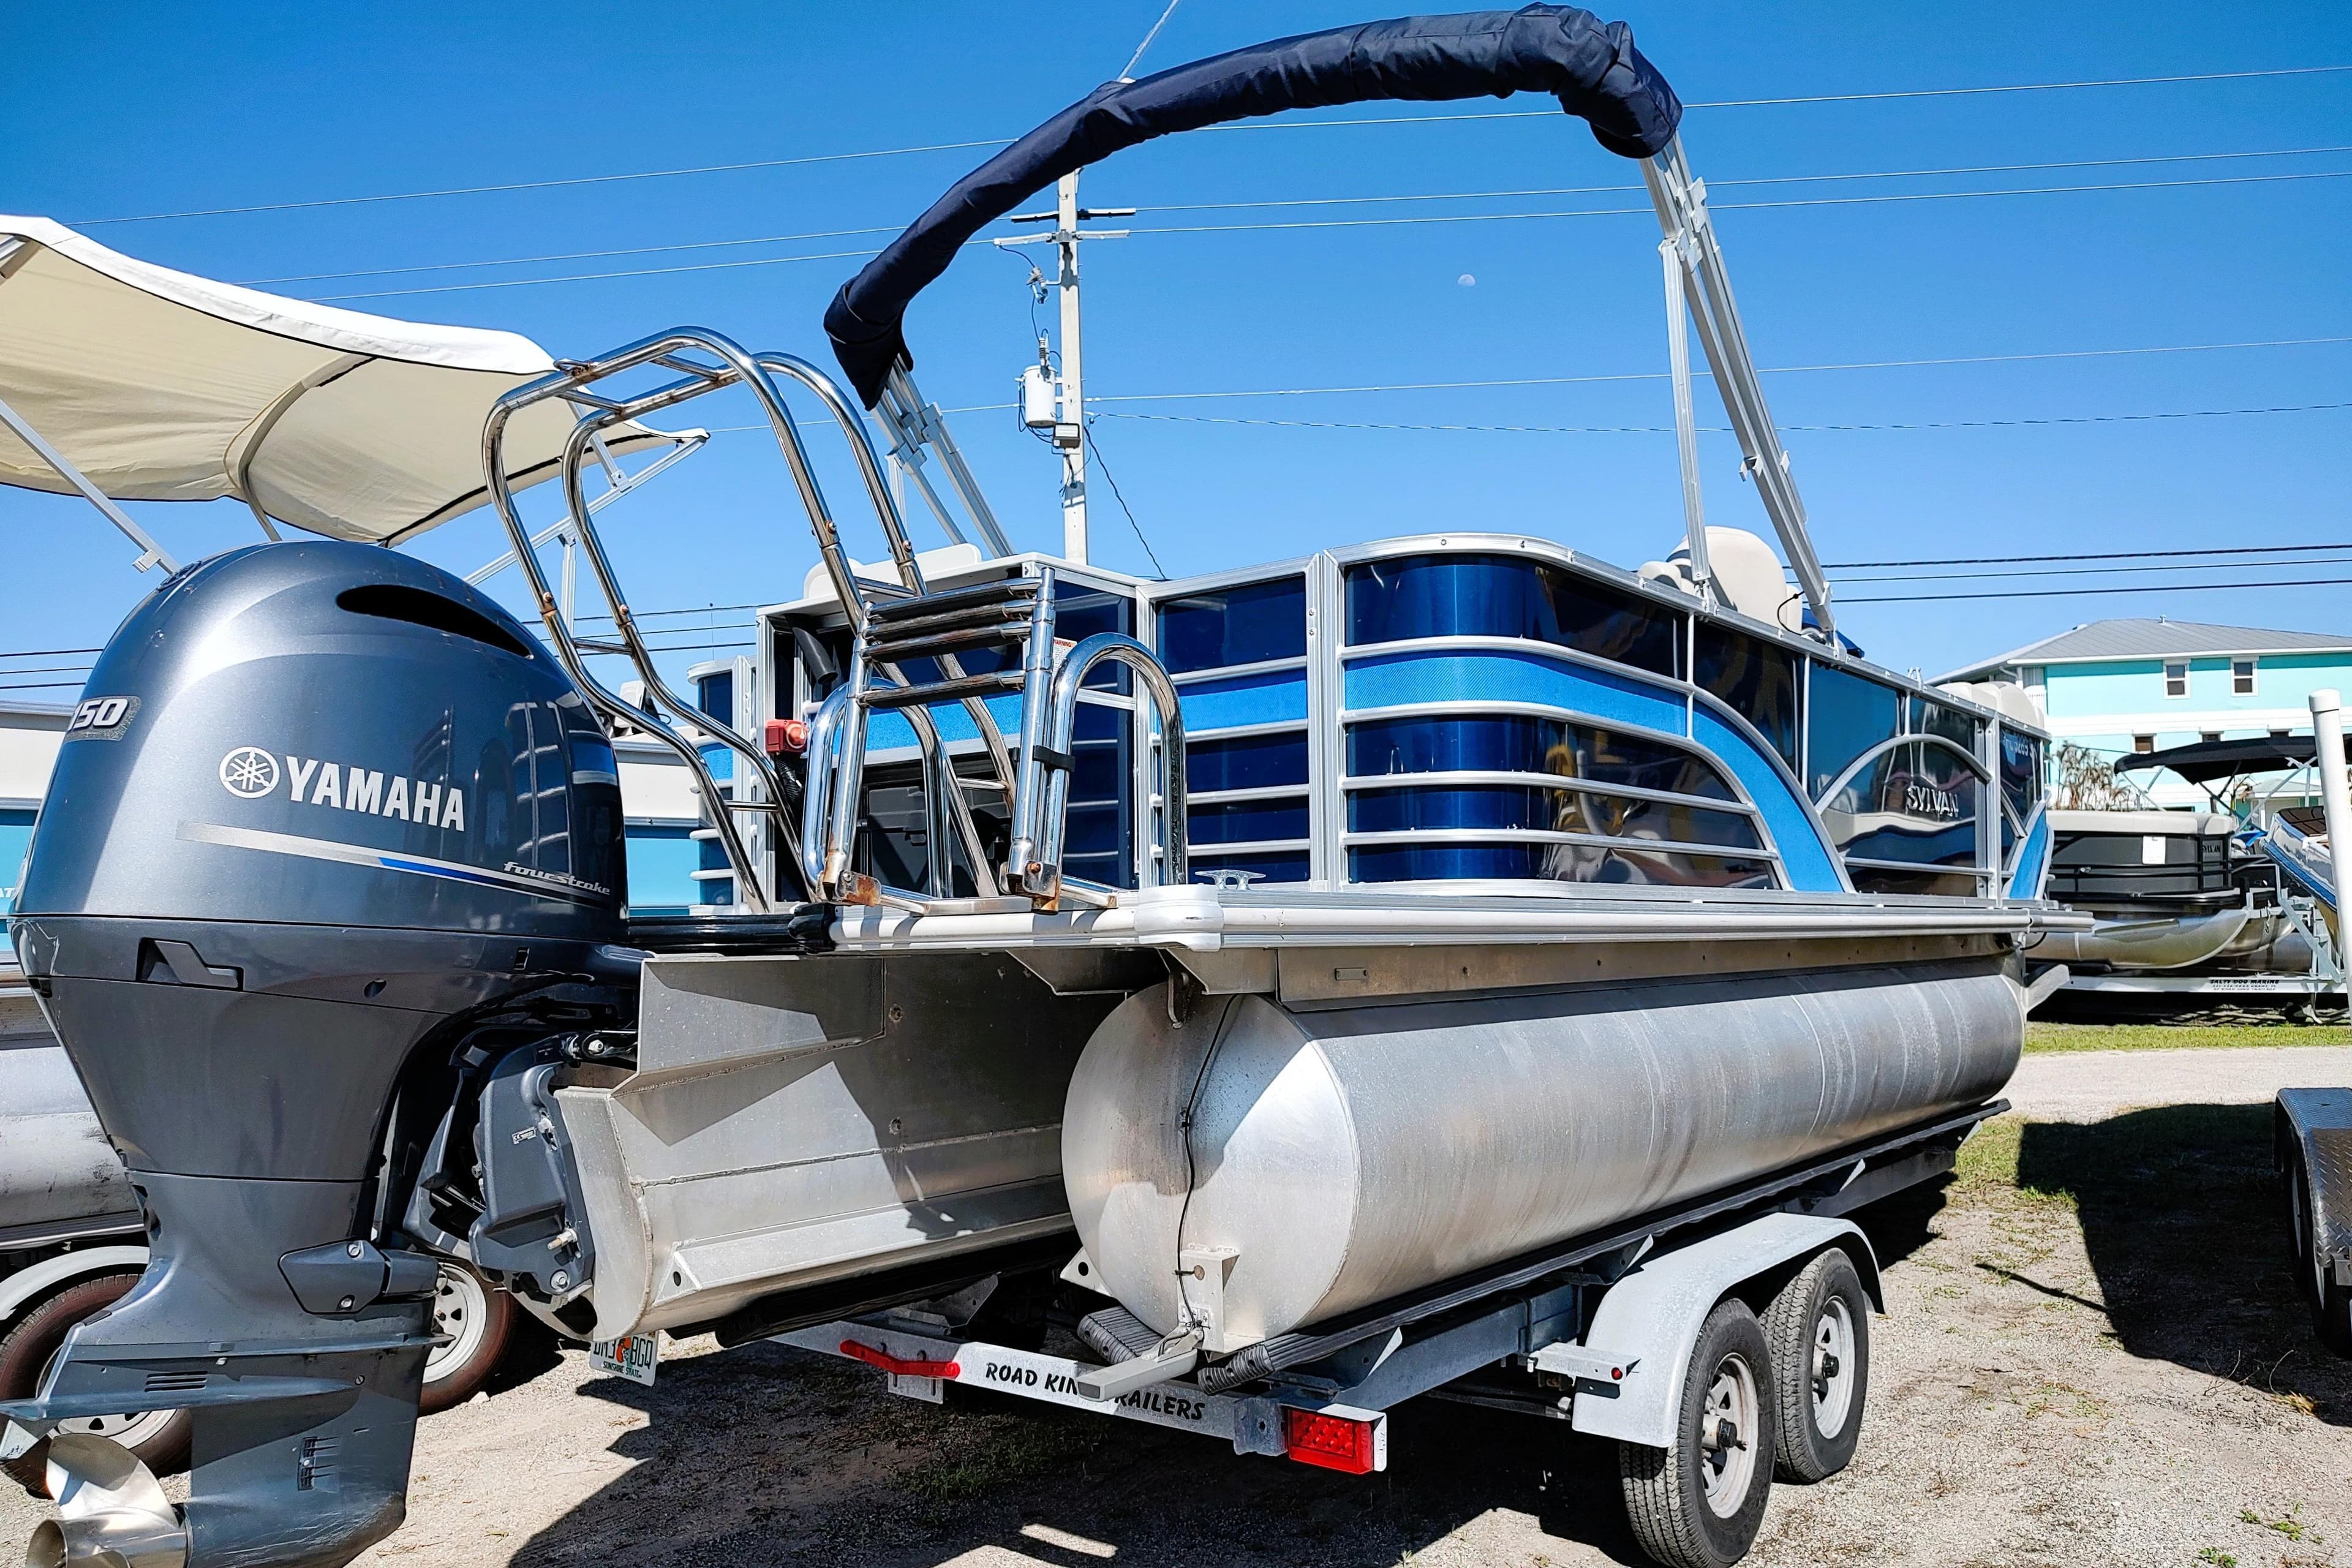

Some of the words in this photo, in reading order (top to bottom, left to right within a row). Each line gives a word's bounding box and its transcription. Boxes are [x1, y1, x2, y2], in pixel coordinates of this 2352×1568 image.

[68, 698, 129, 731] 150
[285, 755, 465, 832] YAMAHA
[1907, 785, 1959, 818] SYLVAN
[986, 1362, 1038, 1387] ROAD
[1044, 1373, 1079, 1396] KIN
[1114, 1390, 1205, 1420] RAILERS
